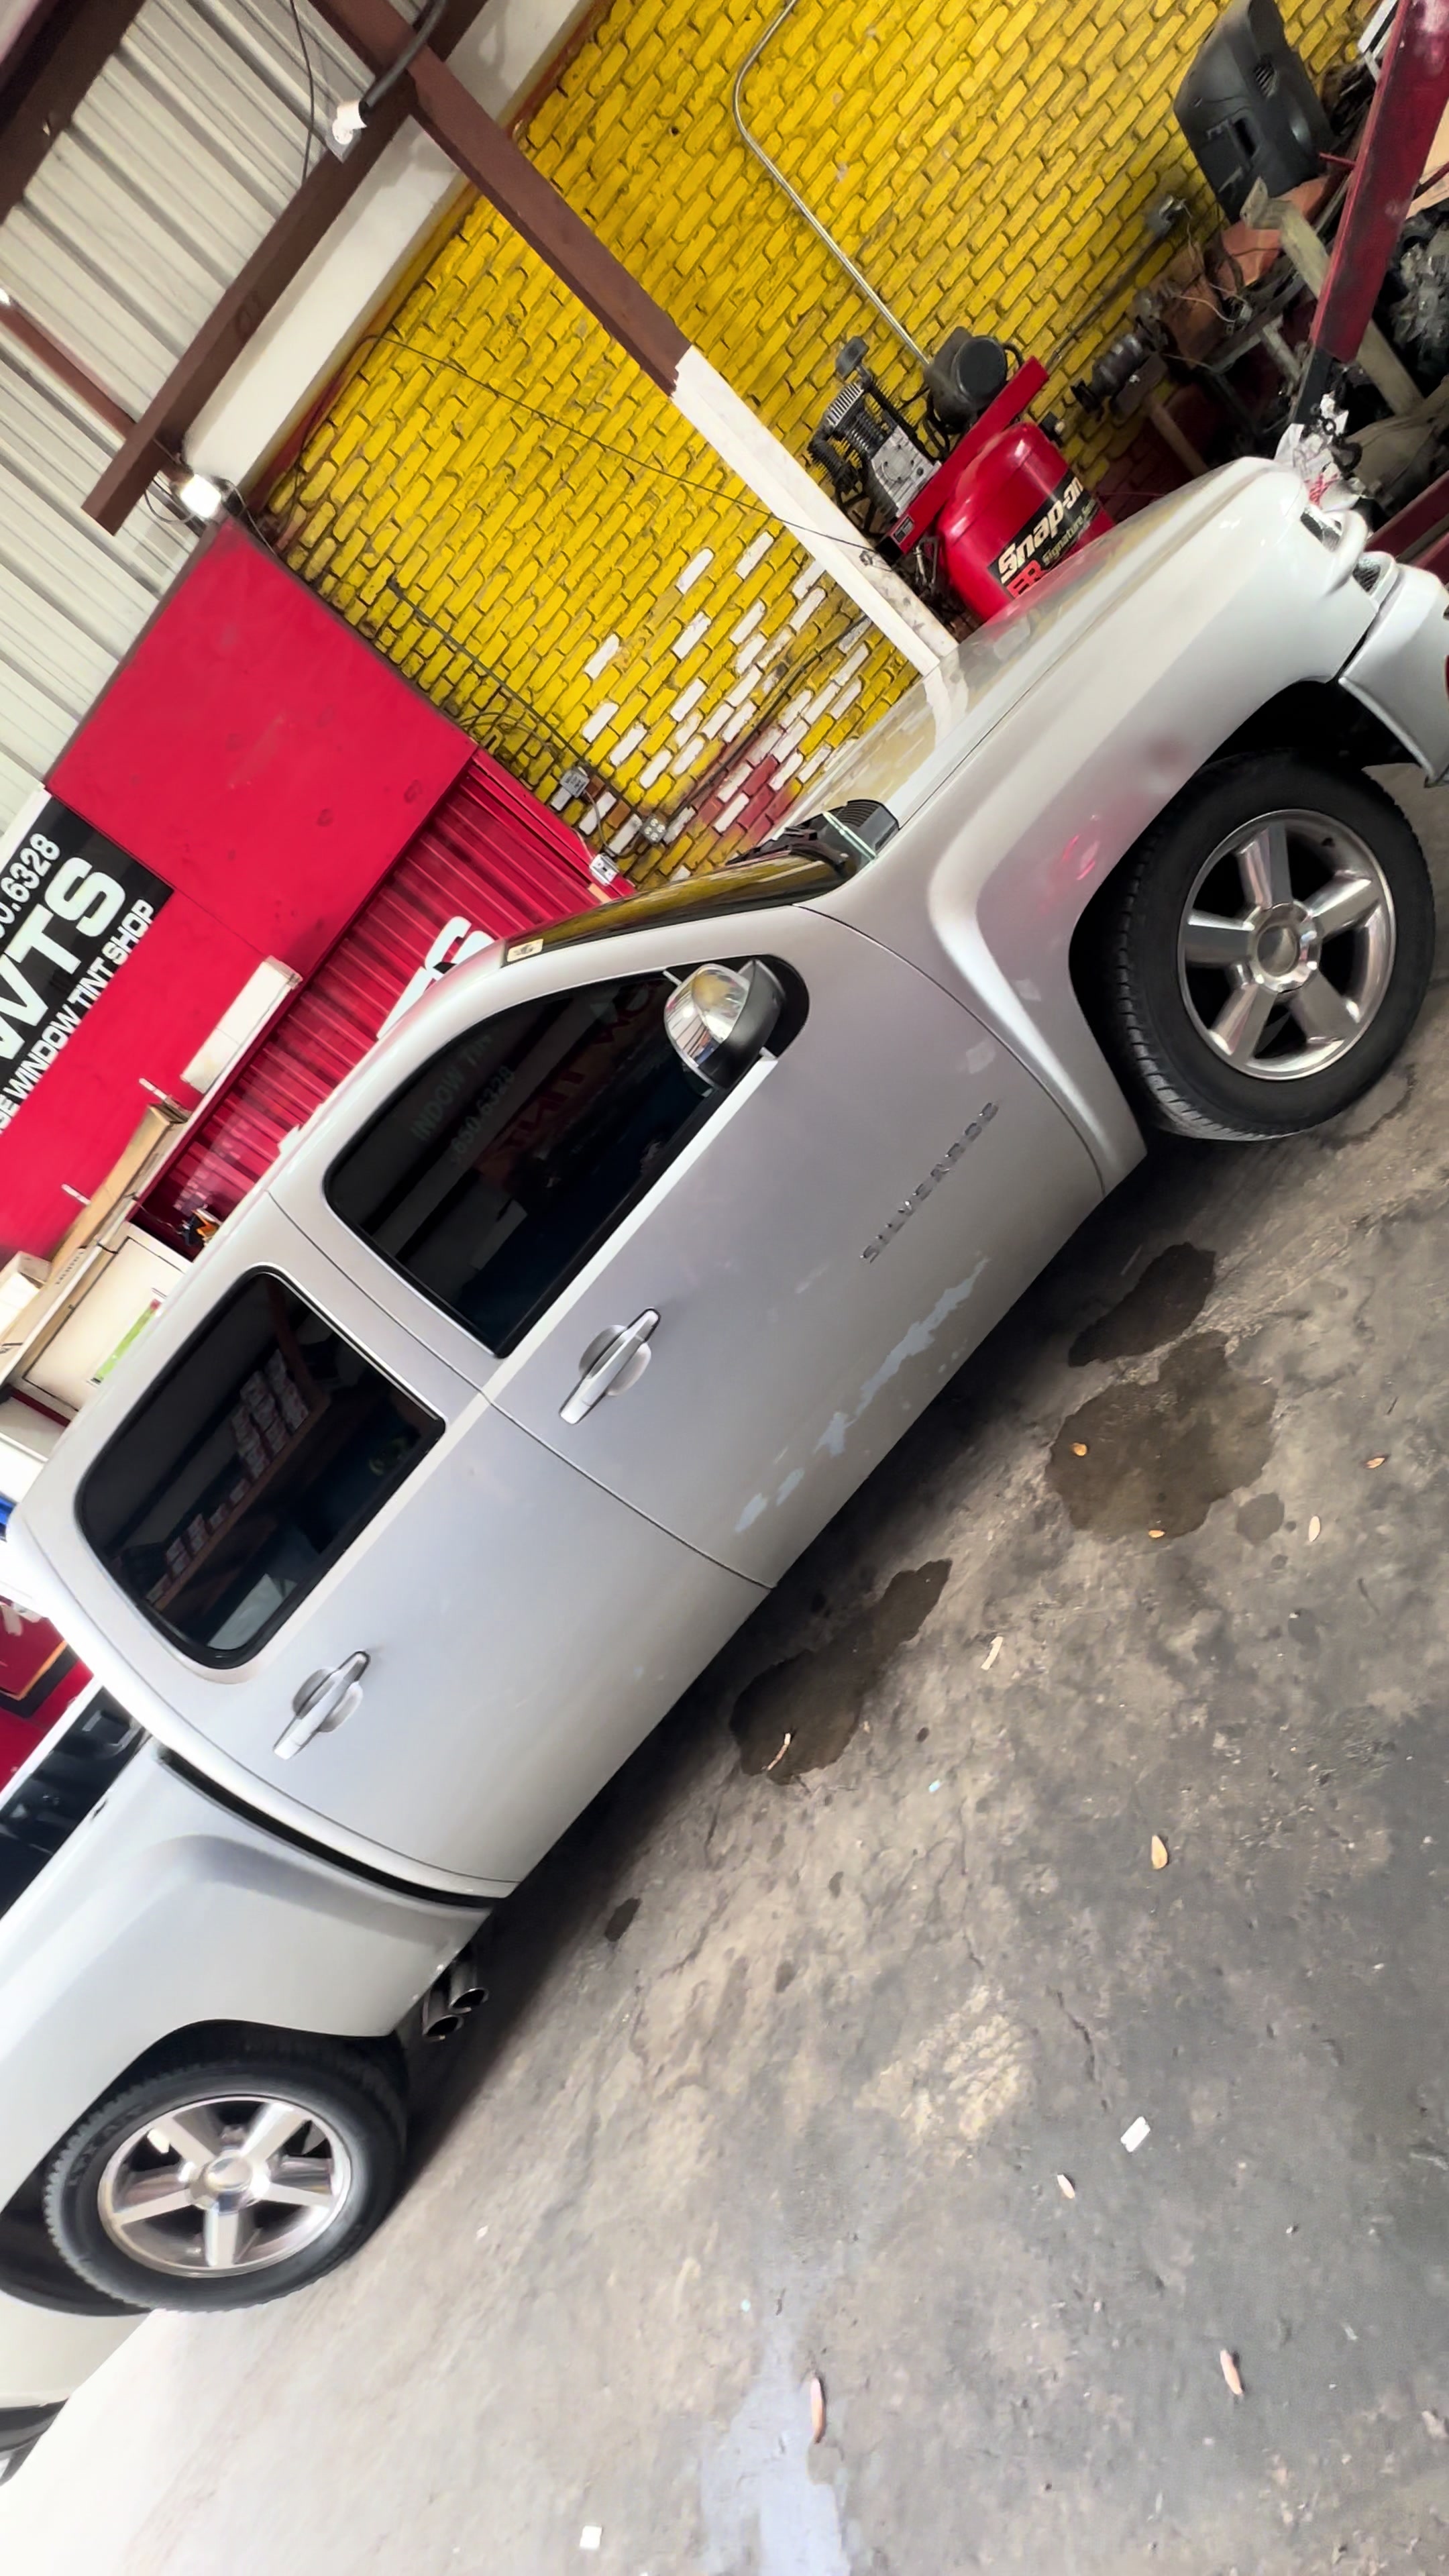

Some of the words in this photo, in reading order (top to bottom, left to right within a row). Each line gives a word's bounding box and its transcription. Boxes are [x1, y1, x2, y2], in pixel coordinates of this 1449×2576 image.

[998, 476, 1084, 584] Snap-on
[0, 833, 61, 939] 0.6328
[3, 1004, 83, 1099] WINDOW
[67, 957, 115, 1009] TINT
[101, 899, 154, 965] SHOP
[859, 1102, 1000, 1264] SILVERADO
